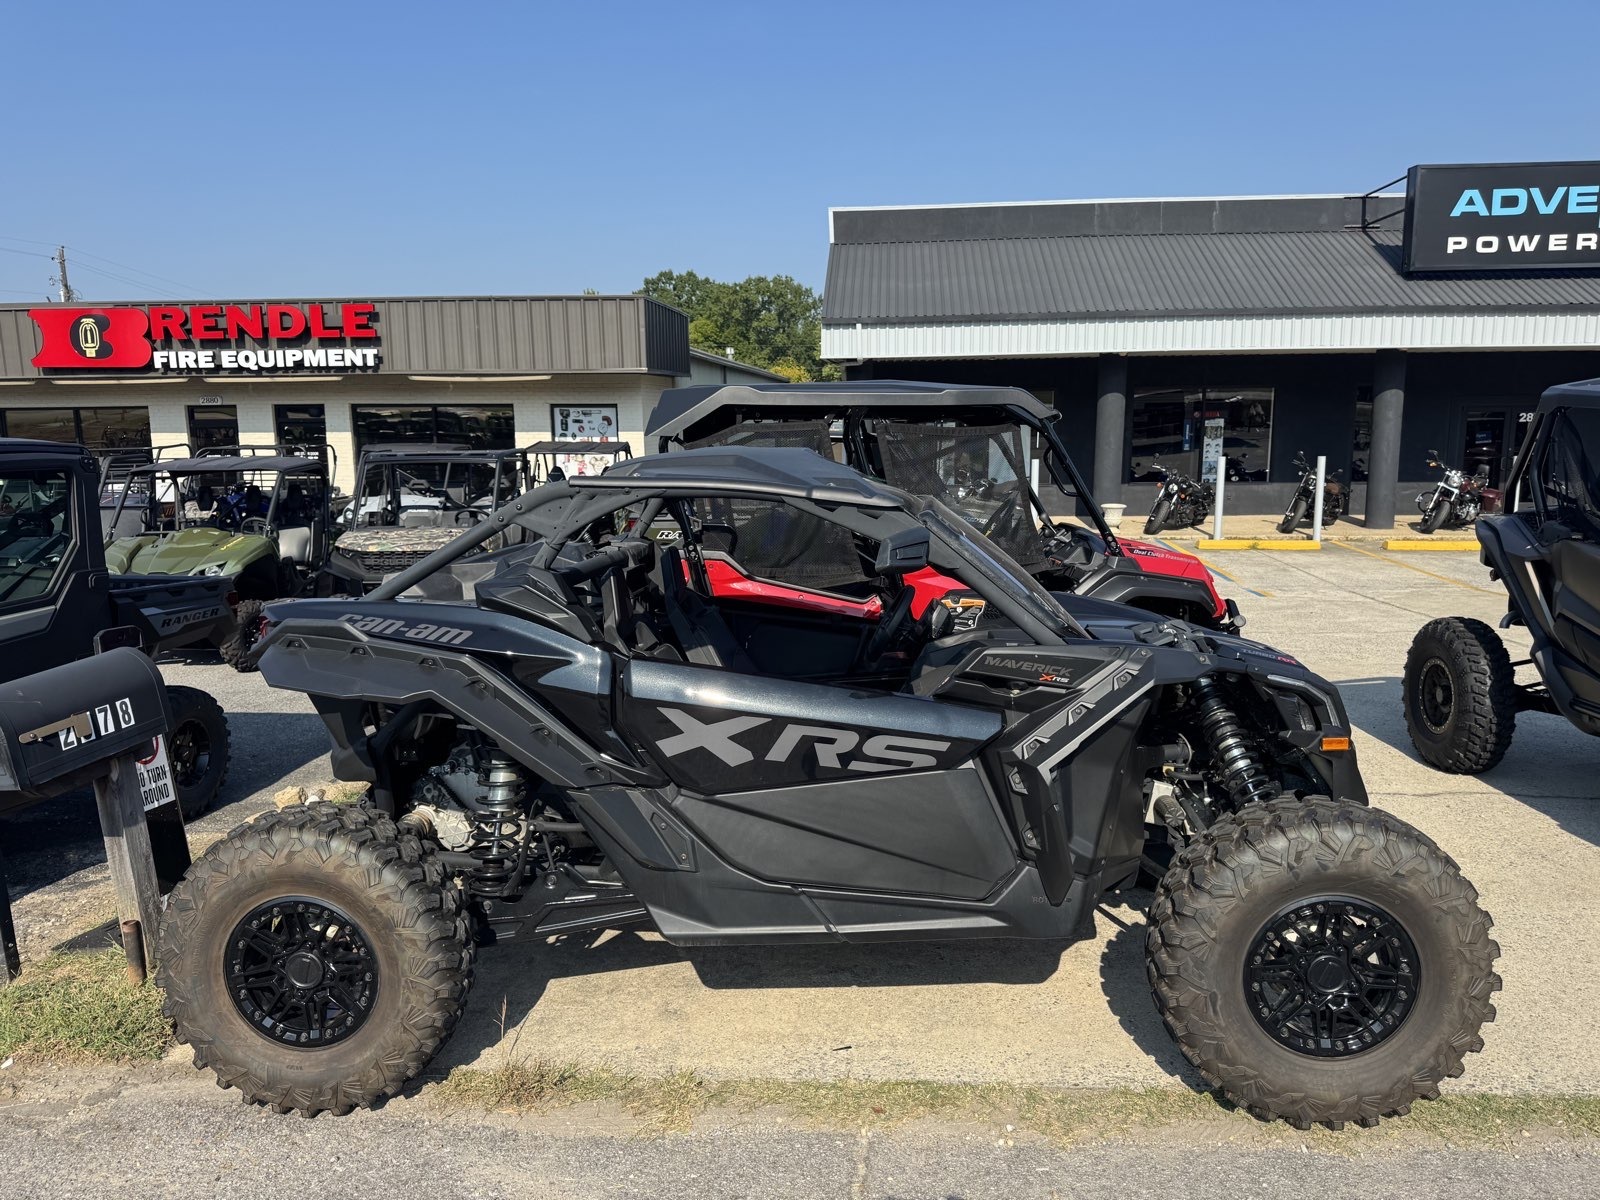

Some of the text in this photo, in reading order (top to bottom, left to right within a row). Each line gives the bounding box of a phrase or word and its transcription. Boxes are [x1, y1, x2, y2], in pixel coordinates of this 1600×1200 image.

[1450, 186, 1600, 217] ADVE
[1447, 233, 1598, 254] POWER
[153, 349, 378, 370] FIRE EQUIPMENT
[1519, 412, 1536, 423] 28
[656, 530, 683, 540] RA
[1147, 550, 1165, 558] Clutch
[161, 607, 219, 628] RANGER
[984, 656, 1075, 677] MAVERICK
[1039, 673, 1070, 683] XRS
[63, 700, 132, 749] 278
[655, 706, 951, 773] XRS
[146, 764, 168, 785] TURN
